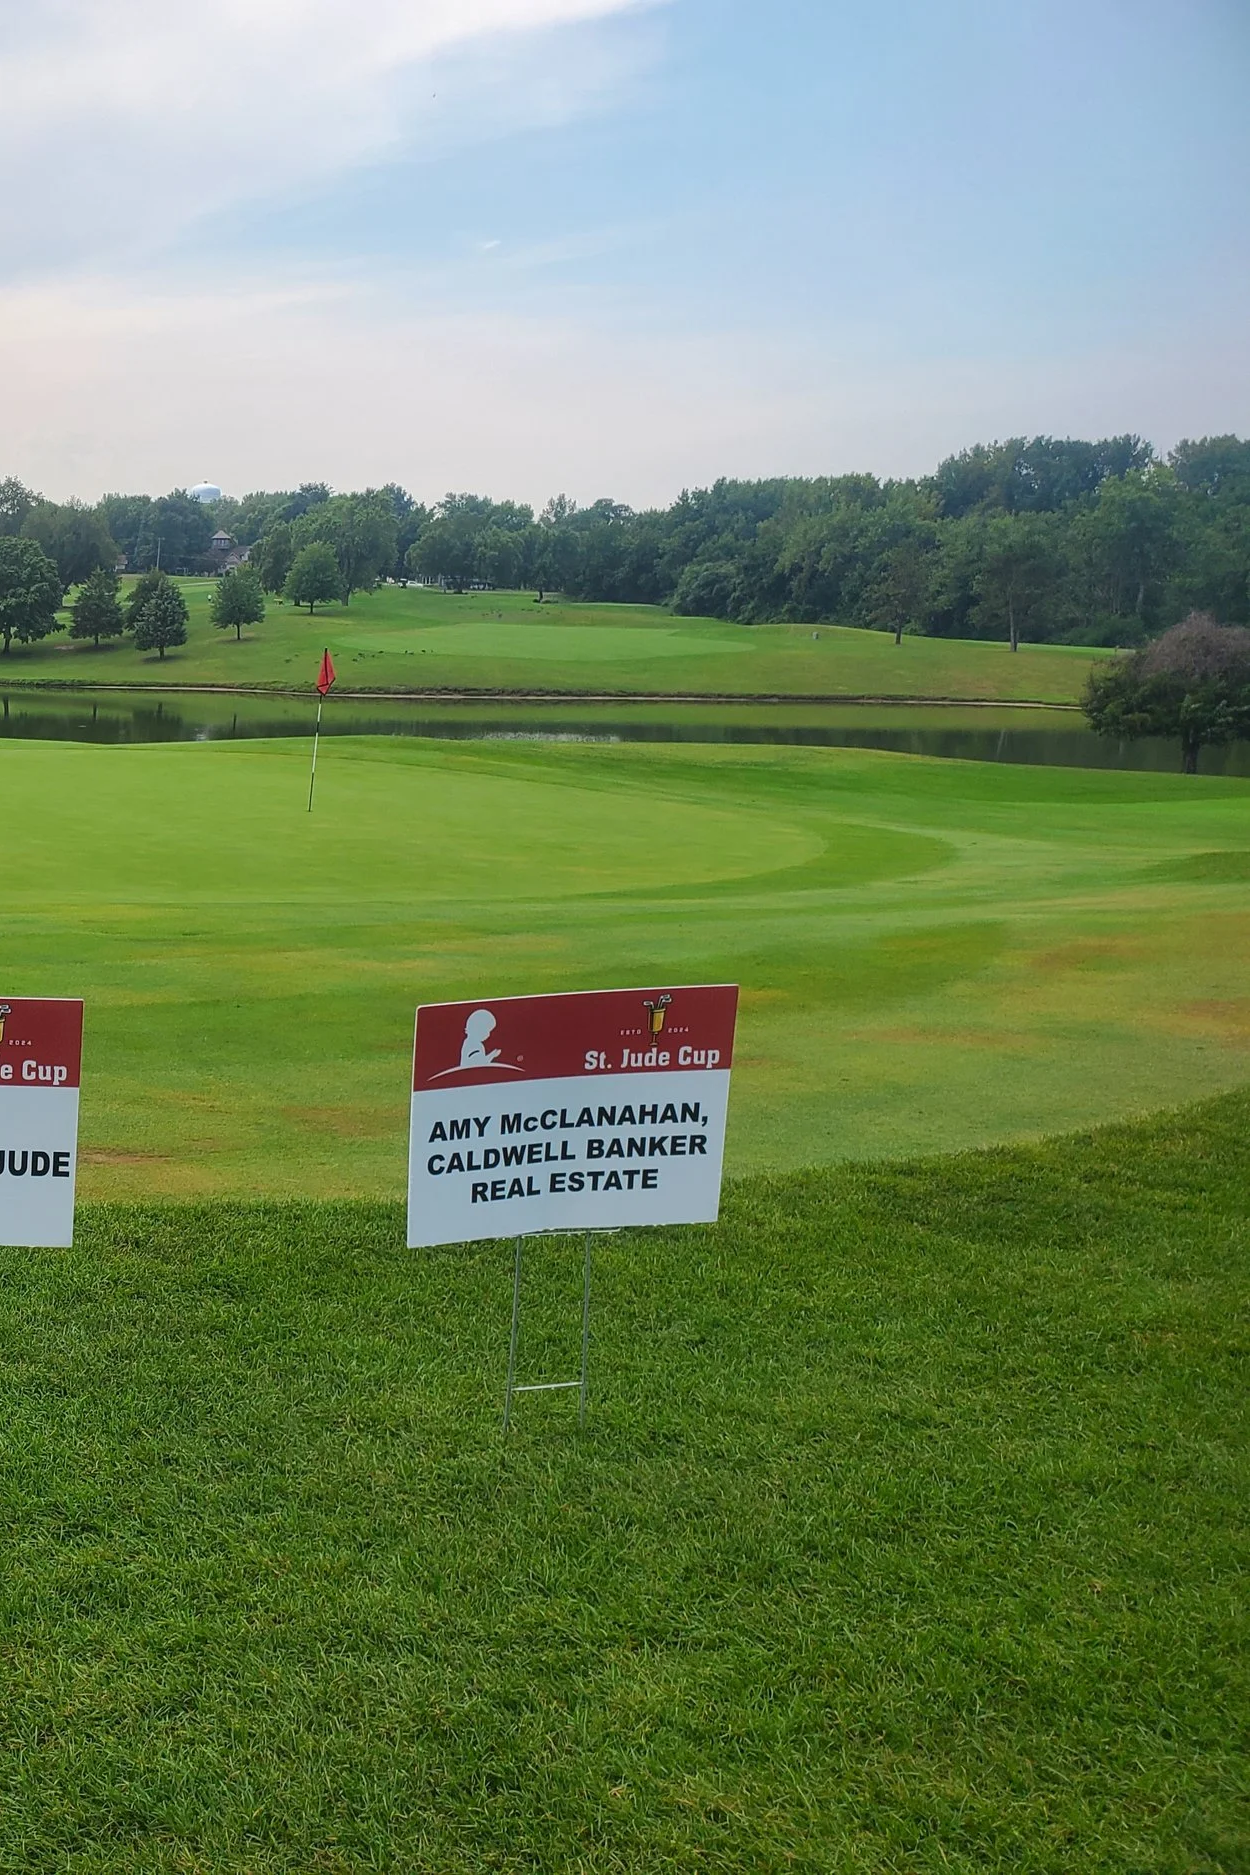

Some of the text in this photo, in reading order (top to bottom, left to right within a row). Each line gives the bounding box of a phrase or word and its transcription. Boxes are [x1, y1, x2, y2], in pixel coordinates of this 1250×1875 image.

[22, 1060, 67, 1085] Cup
[584, 1046, 720, 1070] St. Jude Cup
[428, 1102, 708, 1143] AMY McCLANAHAN,
[427, 1134, 707, 1176] CALDWELL BANKER
[471, 1168, 659, 1203] REAL ESTATE
